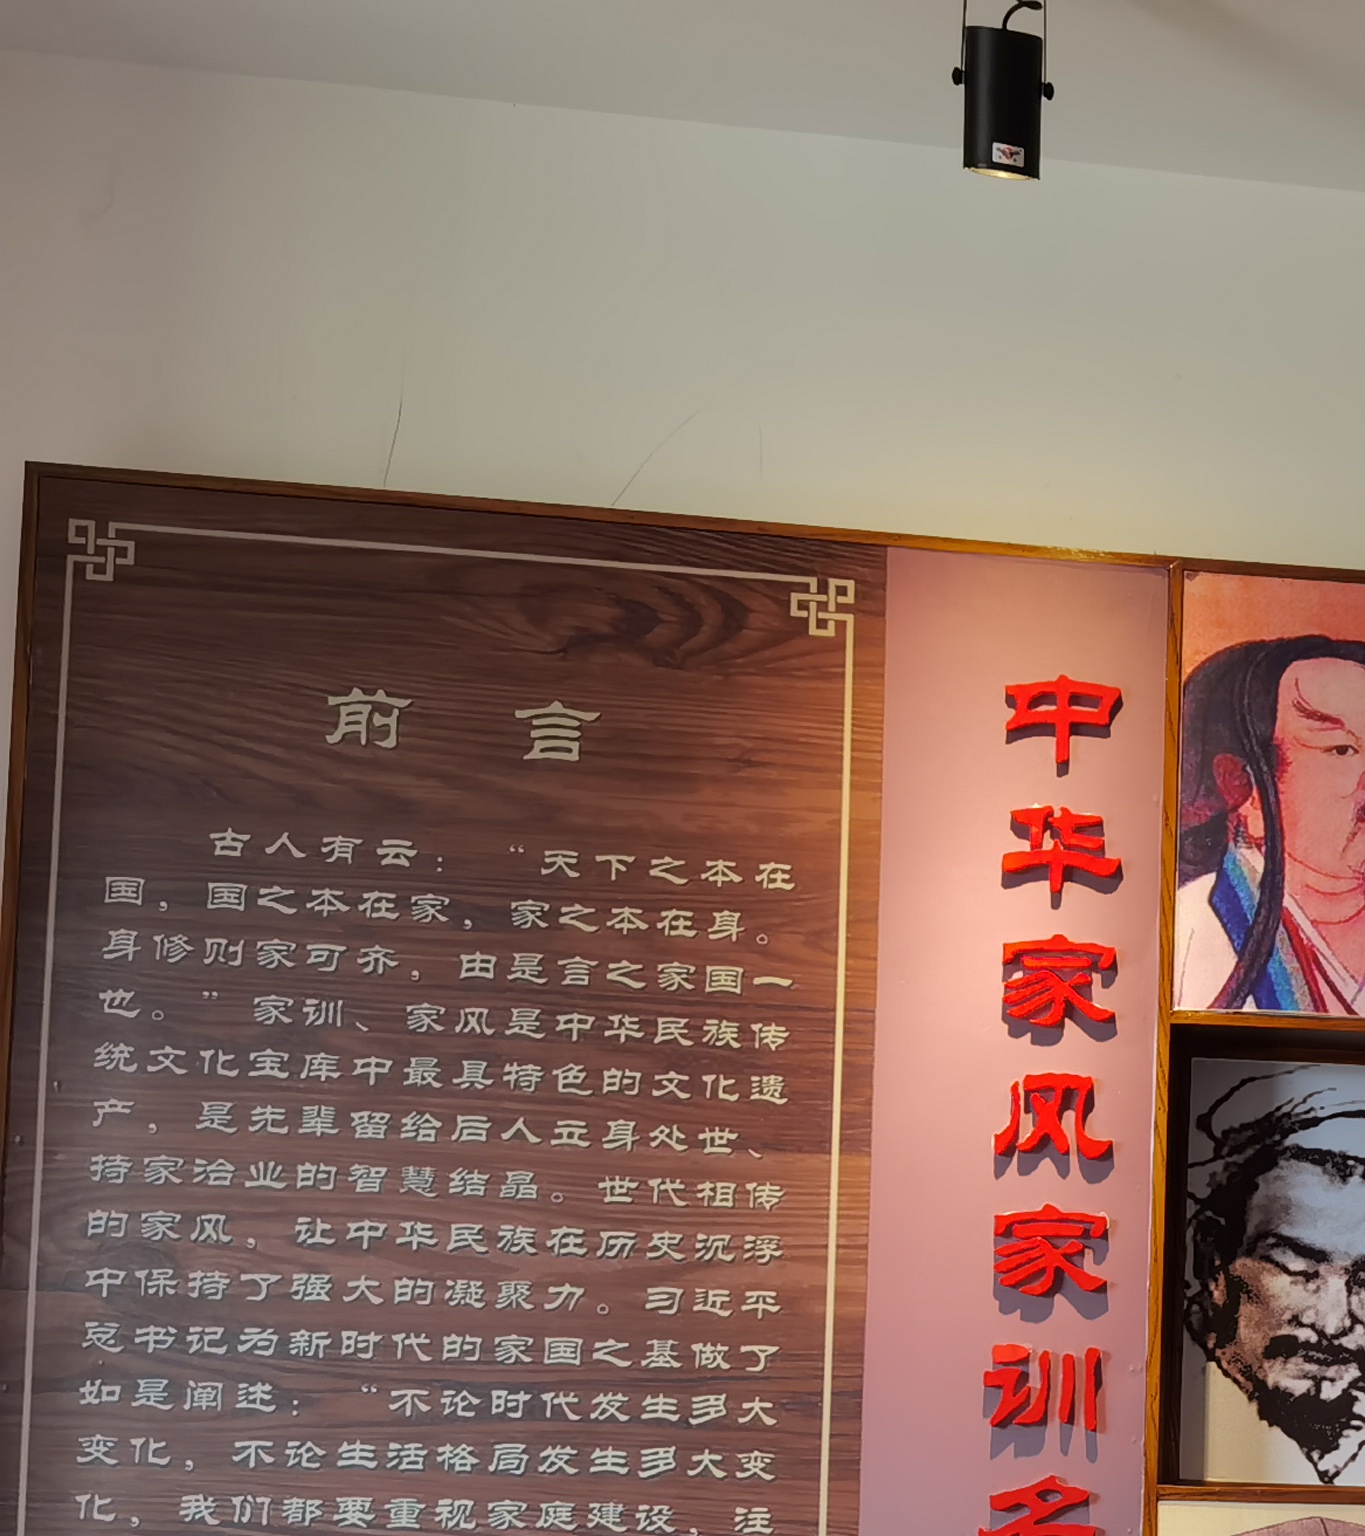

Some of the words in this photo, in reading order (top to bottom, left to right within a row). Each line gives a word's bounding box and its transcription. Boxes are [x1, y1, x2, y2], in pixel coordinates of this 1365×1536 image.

[325, 688, 601, 762] 前言
[94, 1042, 789, 1105] 统文化宝库中最具特色的文化遗
[82, 1322, 781, 1374] 总书记为新时代的家国之基做了
